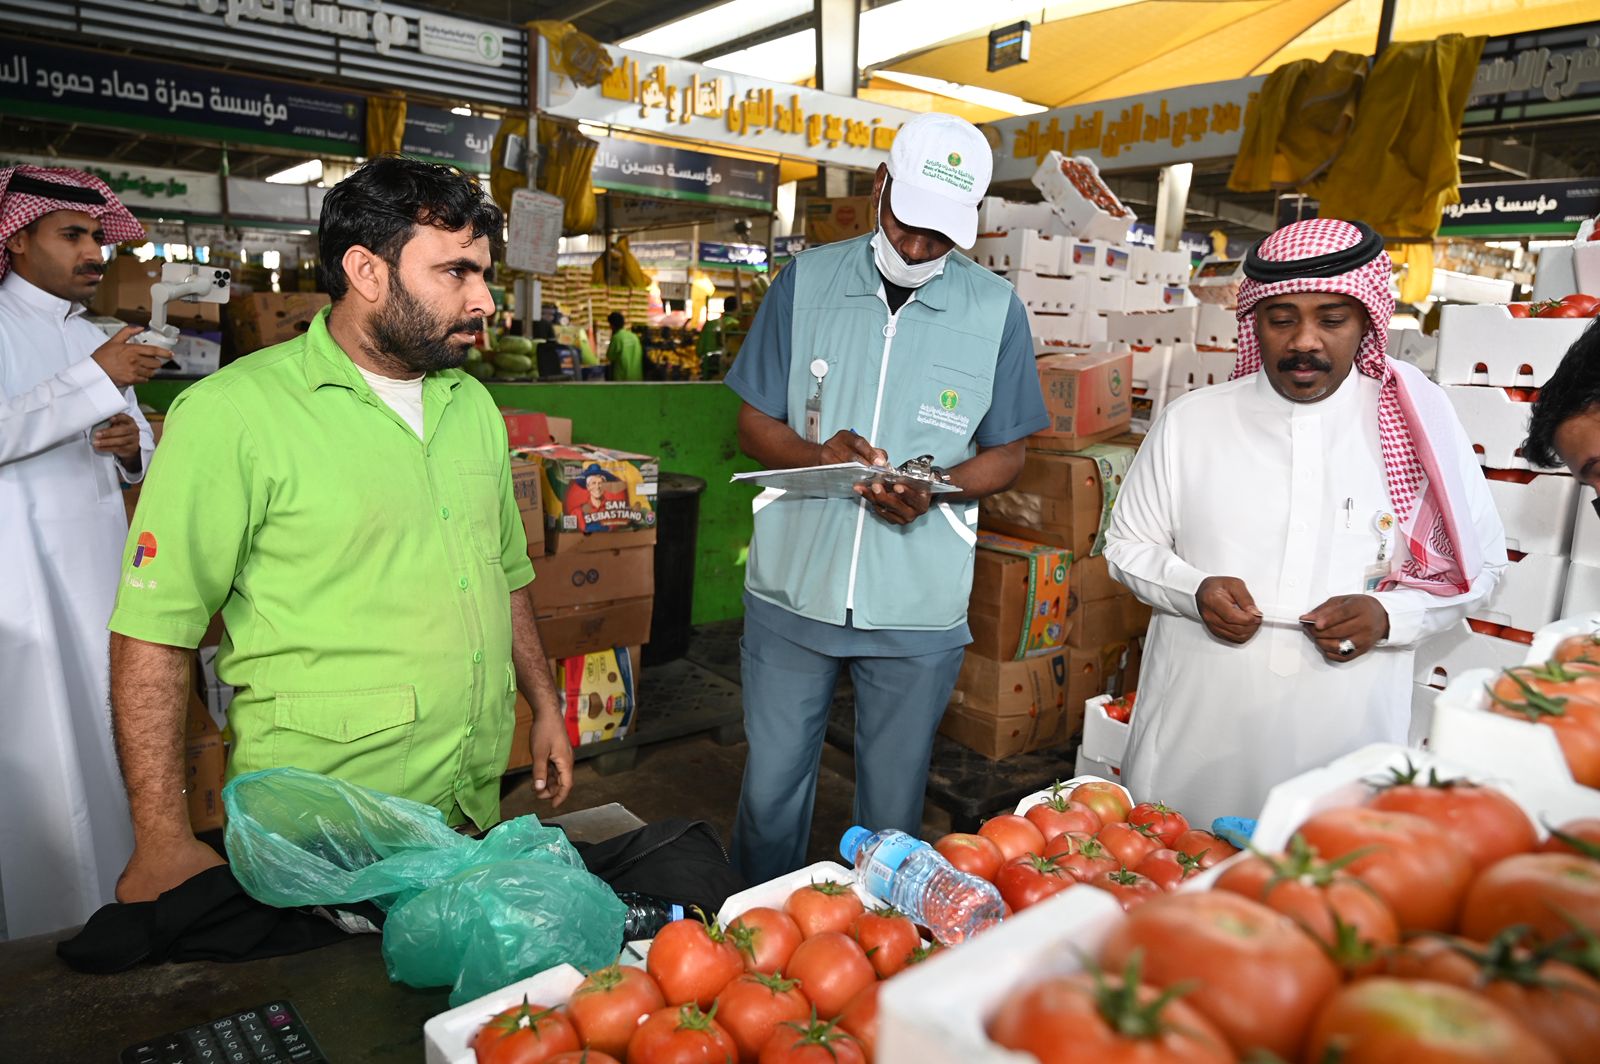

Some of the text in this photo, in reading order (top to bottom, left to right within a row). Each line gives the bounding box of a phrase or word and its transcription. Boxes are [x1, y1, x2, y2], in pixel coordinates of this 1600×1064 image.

[36, 69, 94, 98] حمود
[101, 69, 149, 102] حماد
[155, 78, 204, 113] حمزة
[210, 86, 288, 126] مؤسسة
[621, 158, 665, 176] حسين
[666, 163, 723, 186] مؤسسة
[1495, 194, 1558, 215] مؤسسة
[605, 500, 626, 510] SAN
[584, 510, 642, 524] SEBASTIANO
[198, 1038, 208, 1047] 3
[223, 1030, 233, 1039] 2
[233, 1052, 244, 1061] 8
